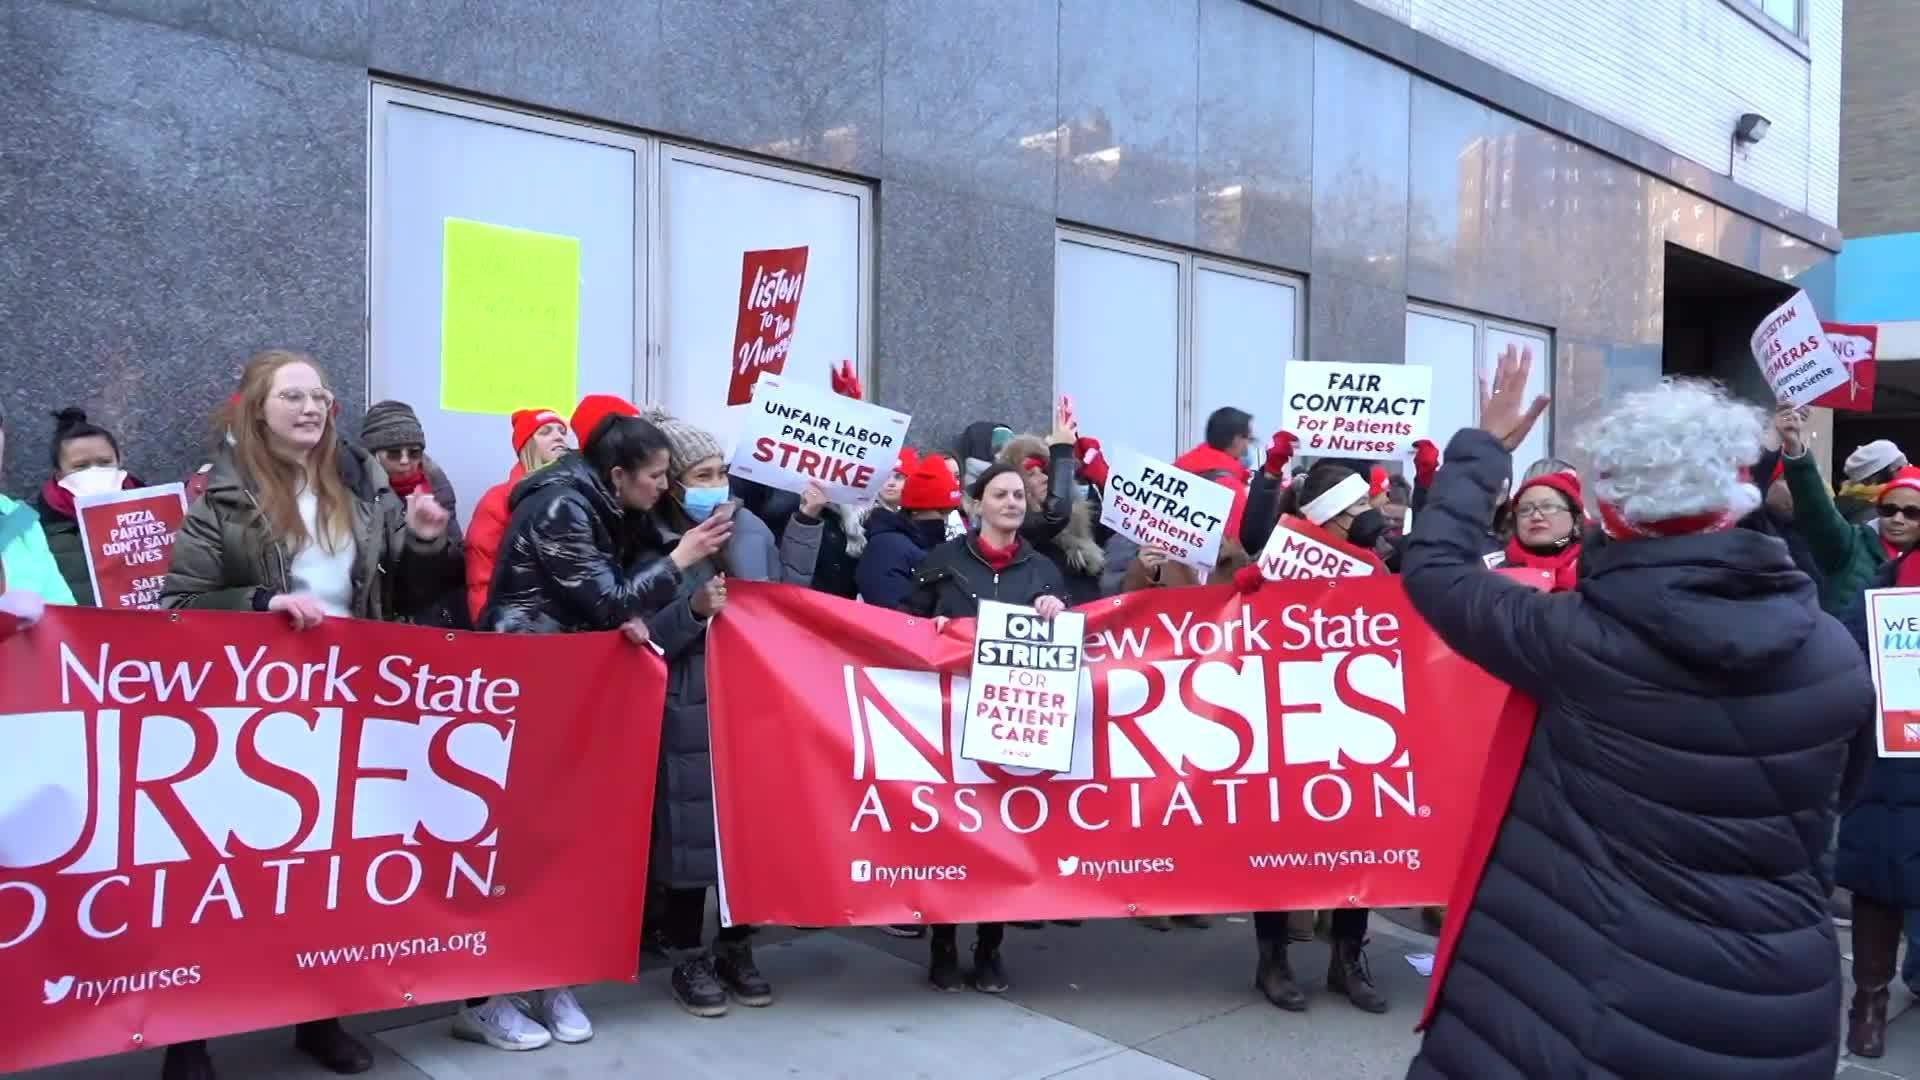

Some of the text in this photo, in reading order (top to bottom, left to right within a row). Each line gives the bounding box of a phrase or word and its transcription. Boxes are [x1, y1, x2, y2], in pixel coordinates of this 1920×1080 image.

[1328, 373, 1381, 392] FAIR
[1290, 393, 1426, 416] CONTRACT
[765, 401, 893, 448] UNFAIR LABOR
[1297, 416, 1412, 436] For Patients
[782, 425, 867, 460] PRACTICE
[1310, 433, 1396, 453] & Nurses
[752, 437, 875, 489] STRIKE
[1140, 467, 1188, 498] FAIR
[1111, 475, 1221, 532] CONTRACT
[116, 510, 155, 526] PIZZA
[1113, 495, 1204, 548] For Patients
[110, 521, 166, 542] PARTIES
[1121, 517, 1188, 559] & Nurses
[103, 538, 141, 556] DON'T
[125, 549, 163, 566] LIVES
[1282, 535, 1353, 576] MORE
[1008, 616, 1049, 641] ON
[1083, 604, 1399, 662] ew York State
[979, 641, 1075, 669] STRIKE
[59, 642, 520, 716] New York State
[1008, 669, 1047, 689] FOR
[984, 684, 1065, 709] BETTER
[843, 649, 1410, 785] NRSES
[976, 702, 1071, 728] PATIENT
[991, 724, 1049, 745] CARE
[1080, 855, 1175, 880] nynurses
[1249, 847, 1421, 871] www.nysna.org
[875, 864, 967, 888] nynurses
[297, 930, 487, 968] www.nysna.org
[75, 963, 201, 1006] nynurses
